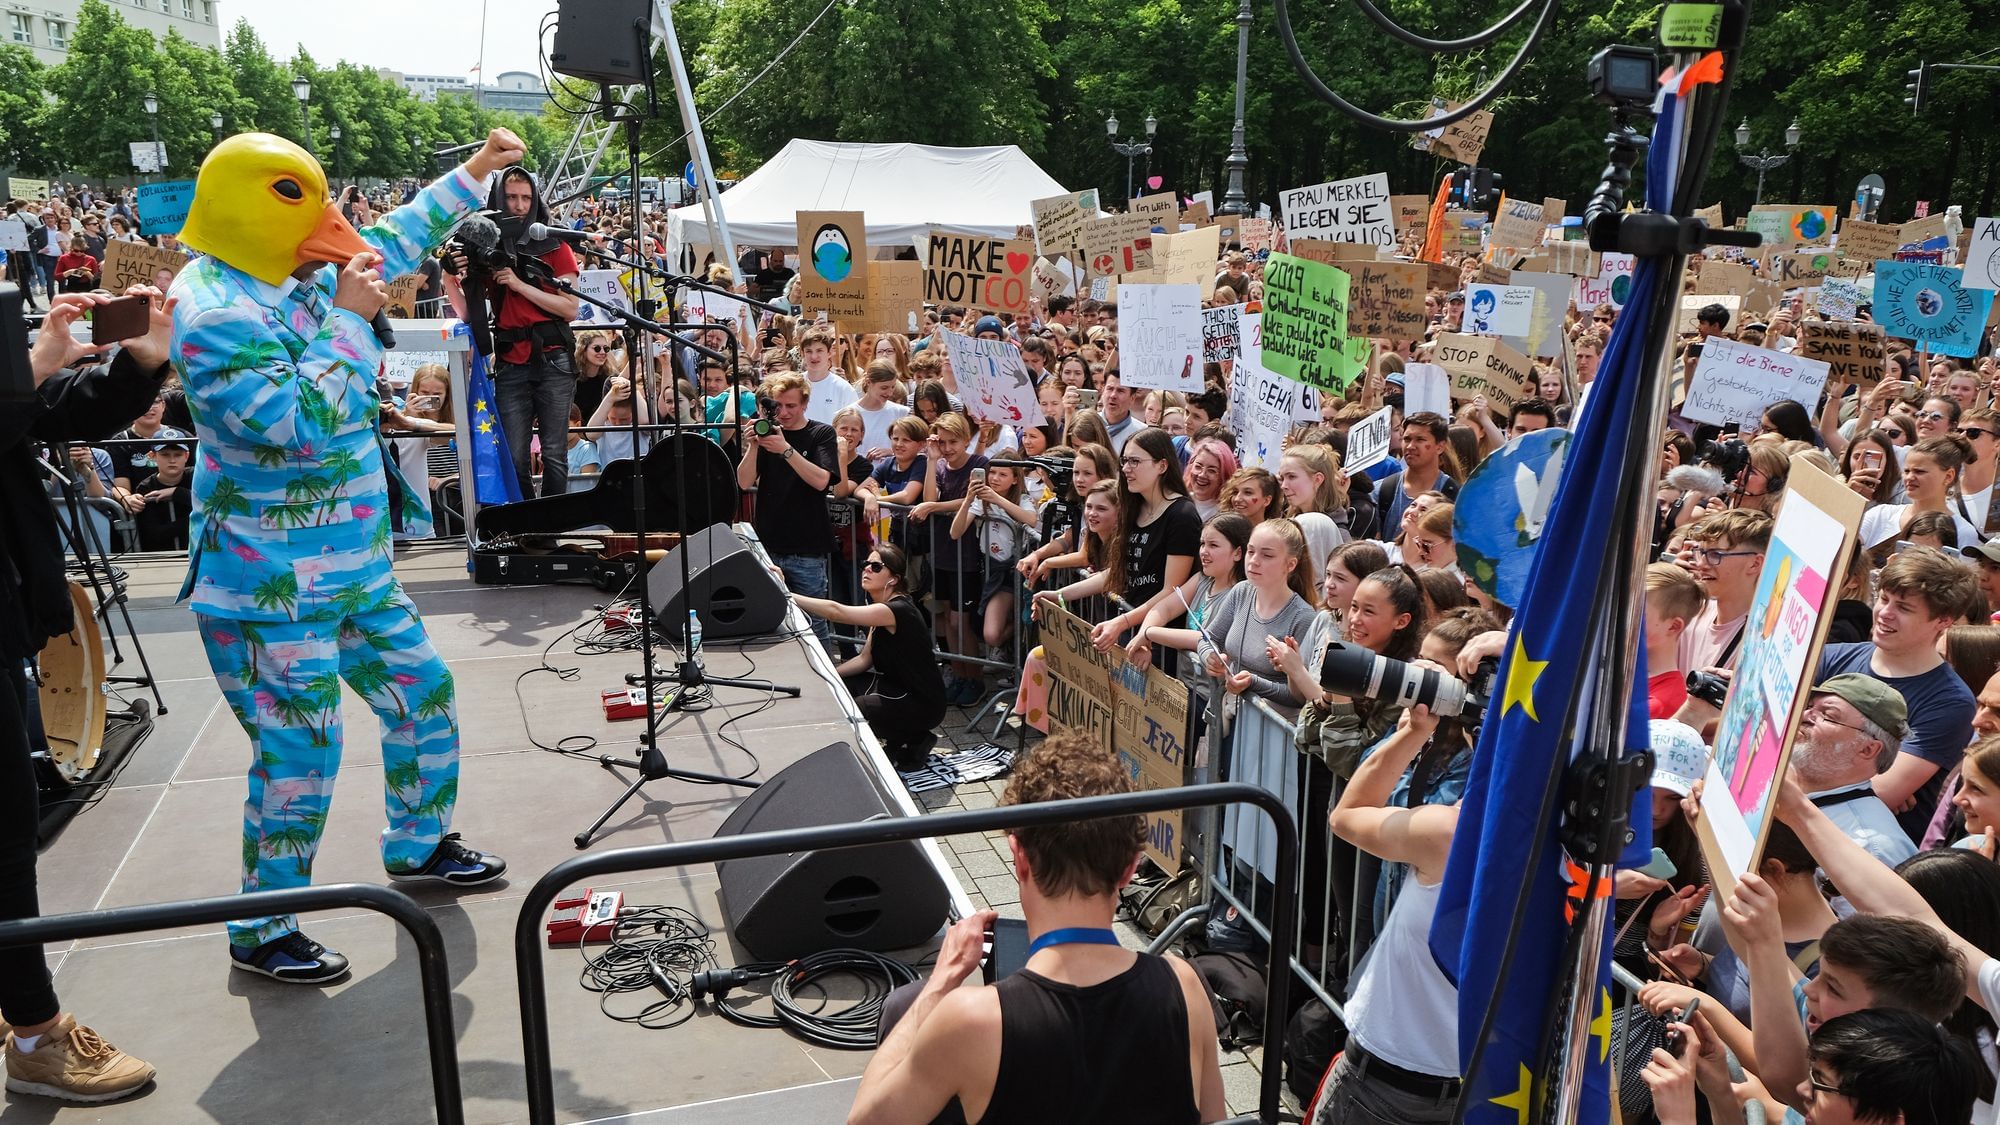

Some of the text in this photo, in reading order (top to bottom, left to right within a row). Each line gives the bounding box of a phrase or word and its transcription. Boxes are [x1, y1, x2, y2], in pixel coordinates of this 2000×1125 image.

[1288, 181, 1389, 208] FRAU MERKEL,
[1290, 208, 1340, 230] LEGEN
[1347, 203, 1386, 225] SIE
[929, 235, 1006, 274] MAKE
[116, 258, 155, 278] HALT
[1362, 266, 1388, 285] Herr
[1617, 259, 1633, 272] ou
[1267, 260, 1305, 296] 2019
[1311, 287, 1321, 303] is
[1894, 265, 1926, 287] LOVE
[1927, 266, 1953, 286] THE
[391, 289, 406, 300] UP
[607, 281, 617, 295] B
[805, 288, 865, 300] save the animals
[927, 269, 986, 304] NOT
[1382, 283, 1414, 300] ihnen
[1580, 277, 1611, 304] Planet
[1887, 285, 1905, 303] WE
[1947, 279, 1975, 315] EARTH
[828, 302, 841, 315] the
[843, 303, 865, 317] earth
[1202, 309, 1226, 325] THIS
[1228, 308, 1238, 321] IS
[1809, 326, 1878, 344] SAVE ME
[1906, 323, 1926, 340] OUR
[1927, 315, 1965, 340] PLANET
[1297, 344, 1318, 363] like
[1808, 340, 1883, 359] SAVE YOU
[1439, 346, 1525, 386] STOP DENYING
[1736, 352, 1755, 368] die
[1758, 355, 1793, 378] Biene
[1830, 361, 1884, 382] AVE US
[1457, 374, 1489, 391] EARTH
[1489, 384, 1497, 398] IS
[1496, 389, 1516, 408] DYIN
[1689, 391, 1743, 420] Nichts zu
[1784, 595, 1809, 646] INGO
[1765, 636, 1795, 719] FUTURE
[1142, 715, 1184, 766] JETZT
[1669, 750, 1689, 766] FOR
[1653, 771, 1690, 790] UTURE
